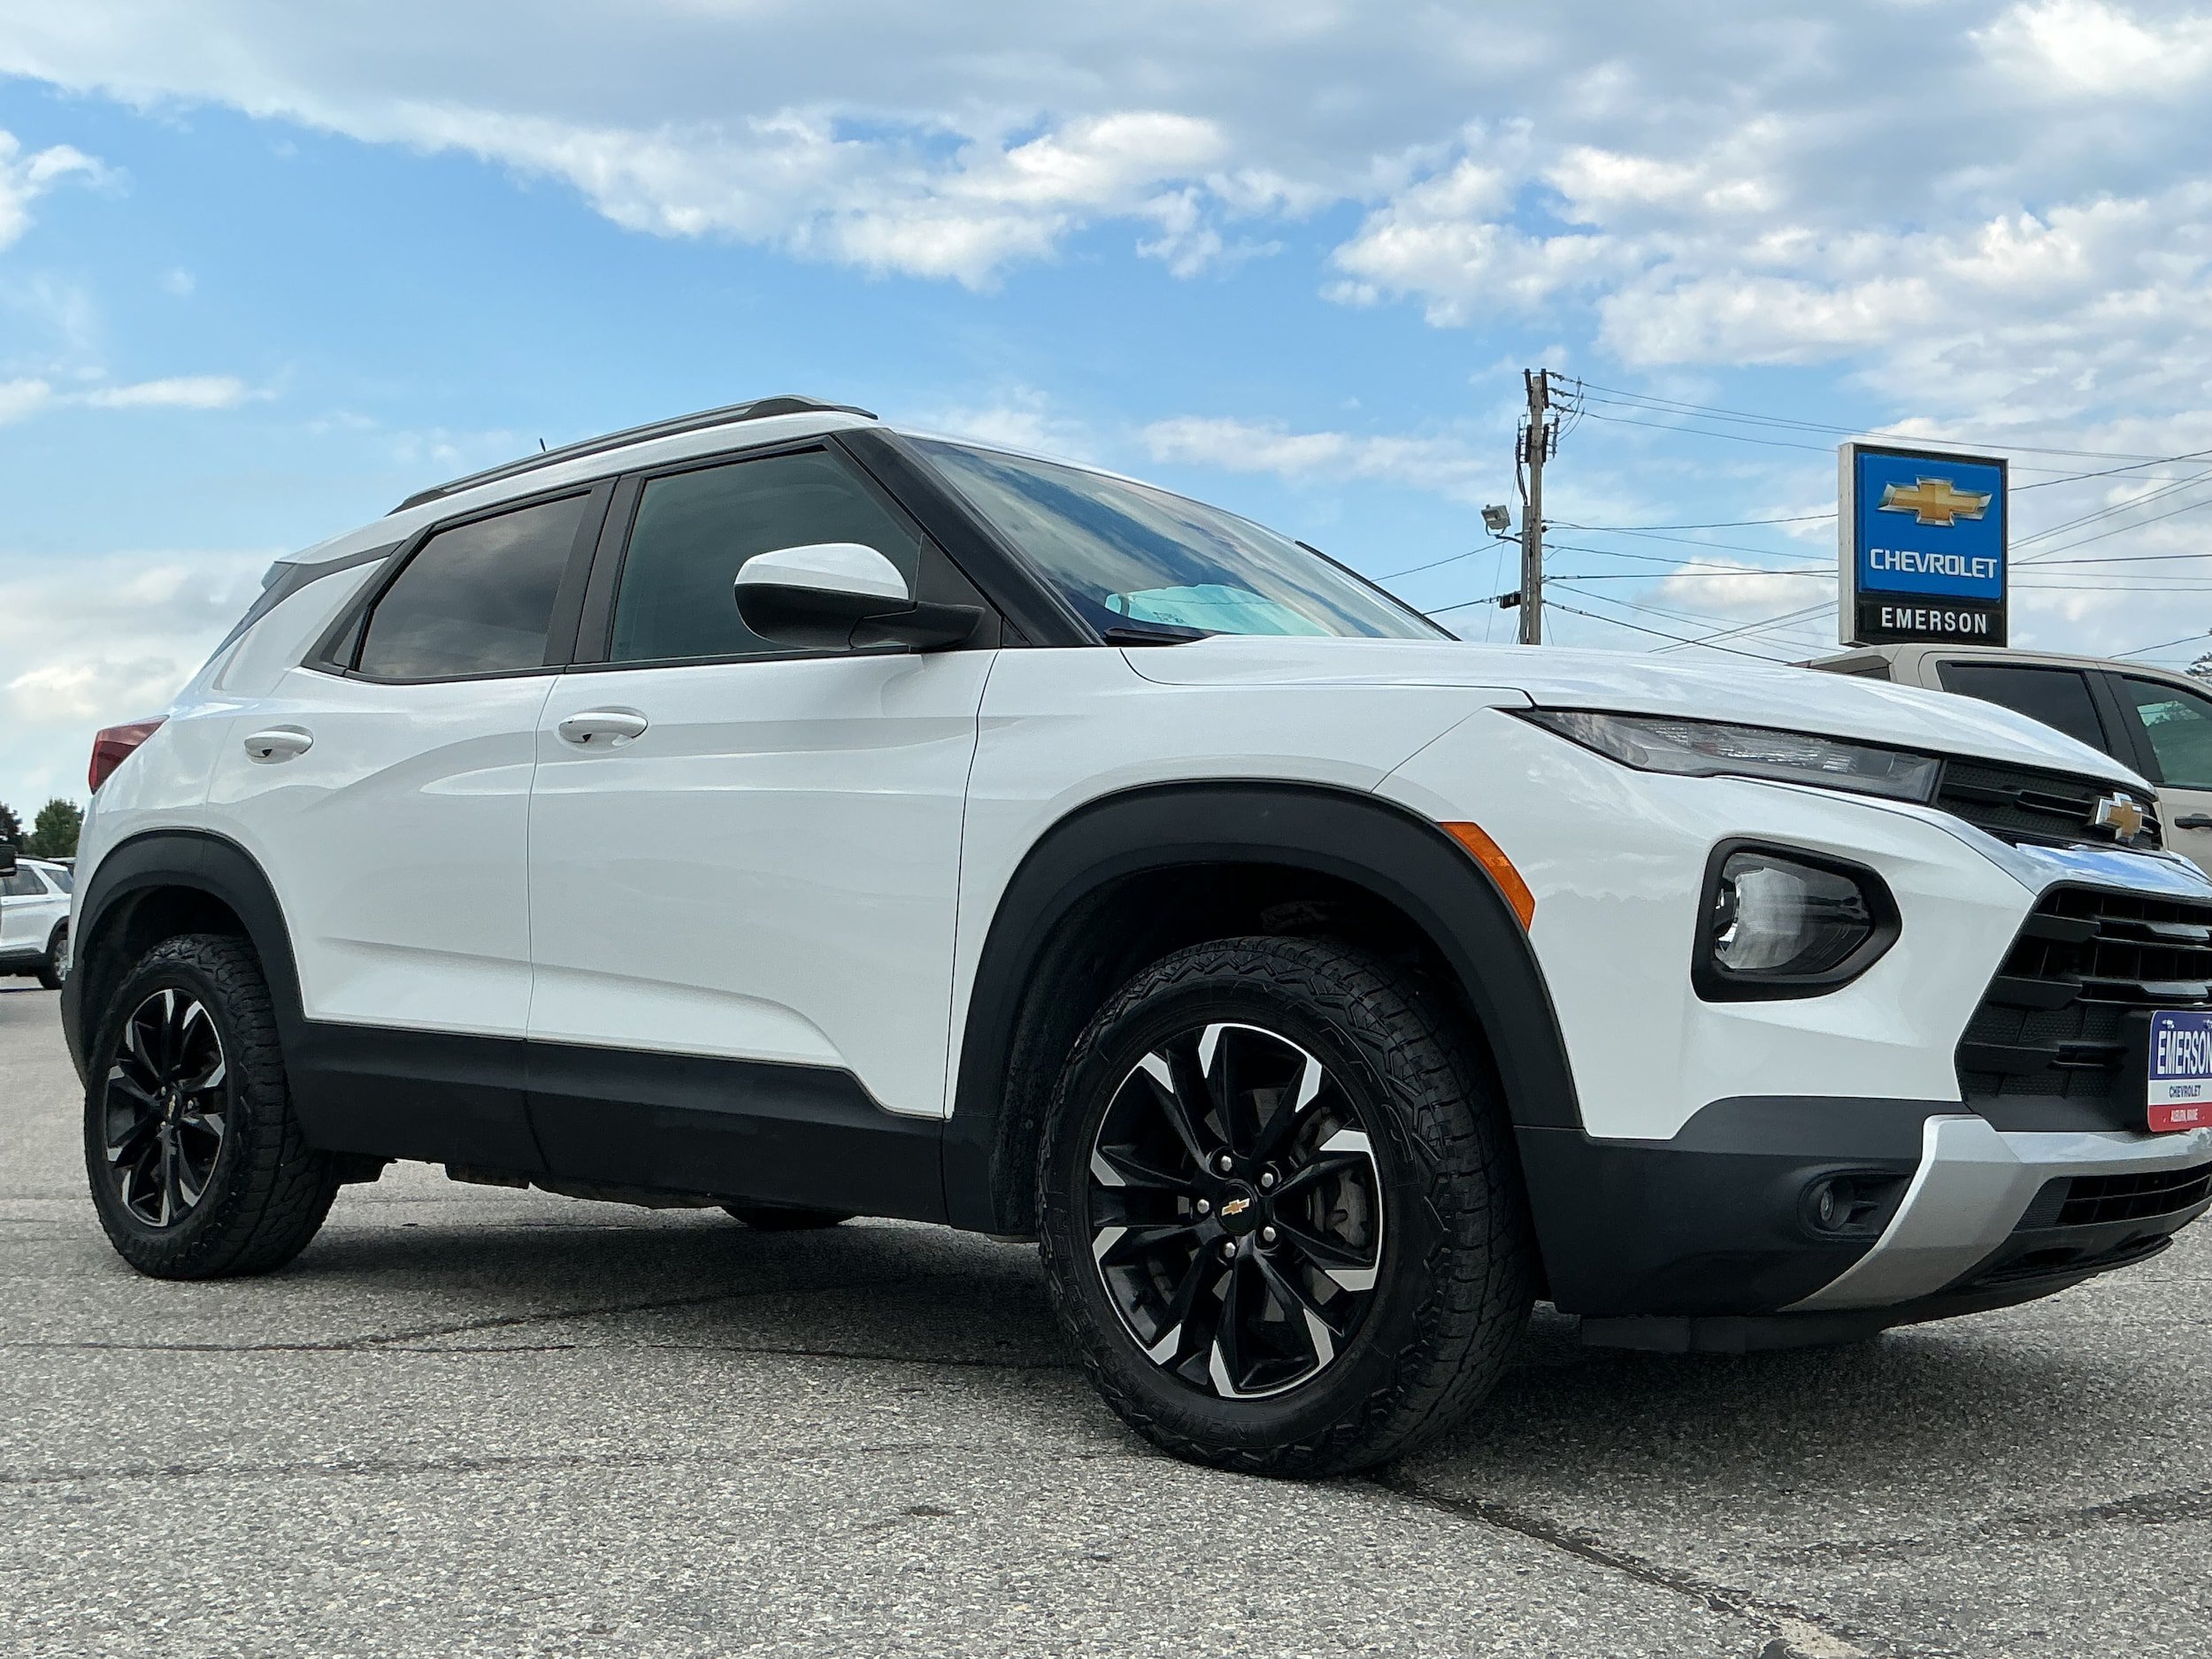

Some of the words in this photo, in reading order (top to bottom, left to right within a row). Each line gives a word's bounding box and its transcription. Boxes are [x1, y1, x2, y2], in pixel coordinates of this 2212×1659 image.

[1870, 549, 1997, 579] CHEVROLET
[1881, 607, 1986, 634] EMERSON
[2170, 1085, 2201, 1098] CHEVROLET
